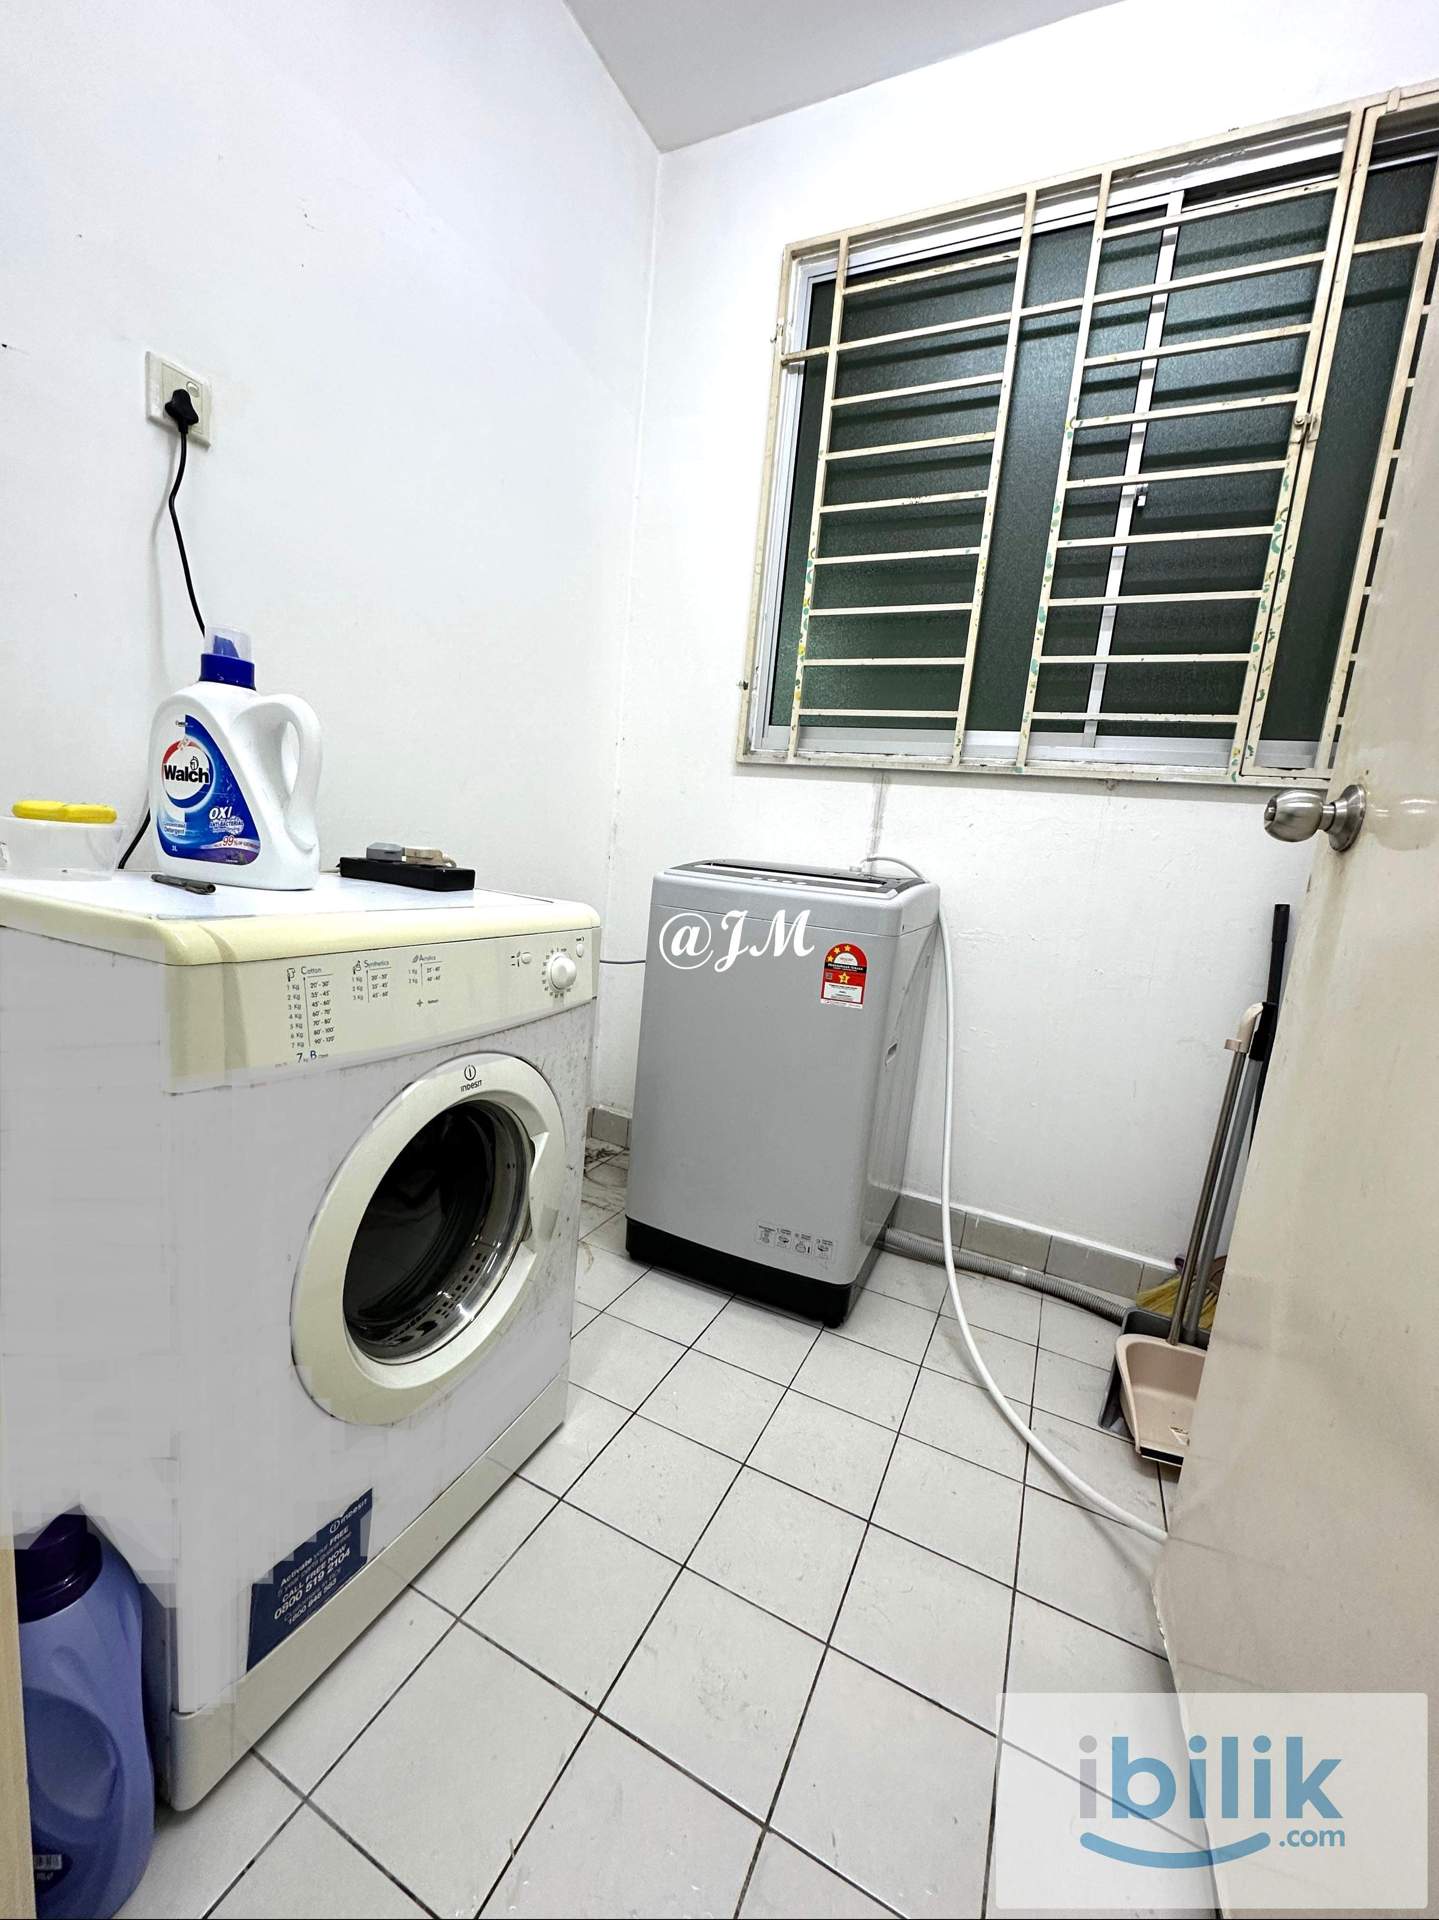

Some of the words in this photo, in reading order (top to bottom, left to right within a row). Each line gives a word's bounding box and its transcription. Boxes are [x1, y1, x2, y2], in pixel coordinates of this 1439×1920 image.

[163, 764, 210, 784] Walch
[209, 806, 232, 820] OXI
[329, 1525, 349, 1545] FREE
[282, 1582, 304, 1602] CALL
[305, 1561, 327, 1583] FREE
[328, 1544, 347, 1563] NOW
[274, 1590, 302, 1620] 0800
[305, 1571, 325, 1592] 519
[326, 1547, 350, 1574] 2104
